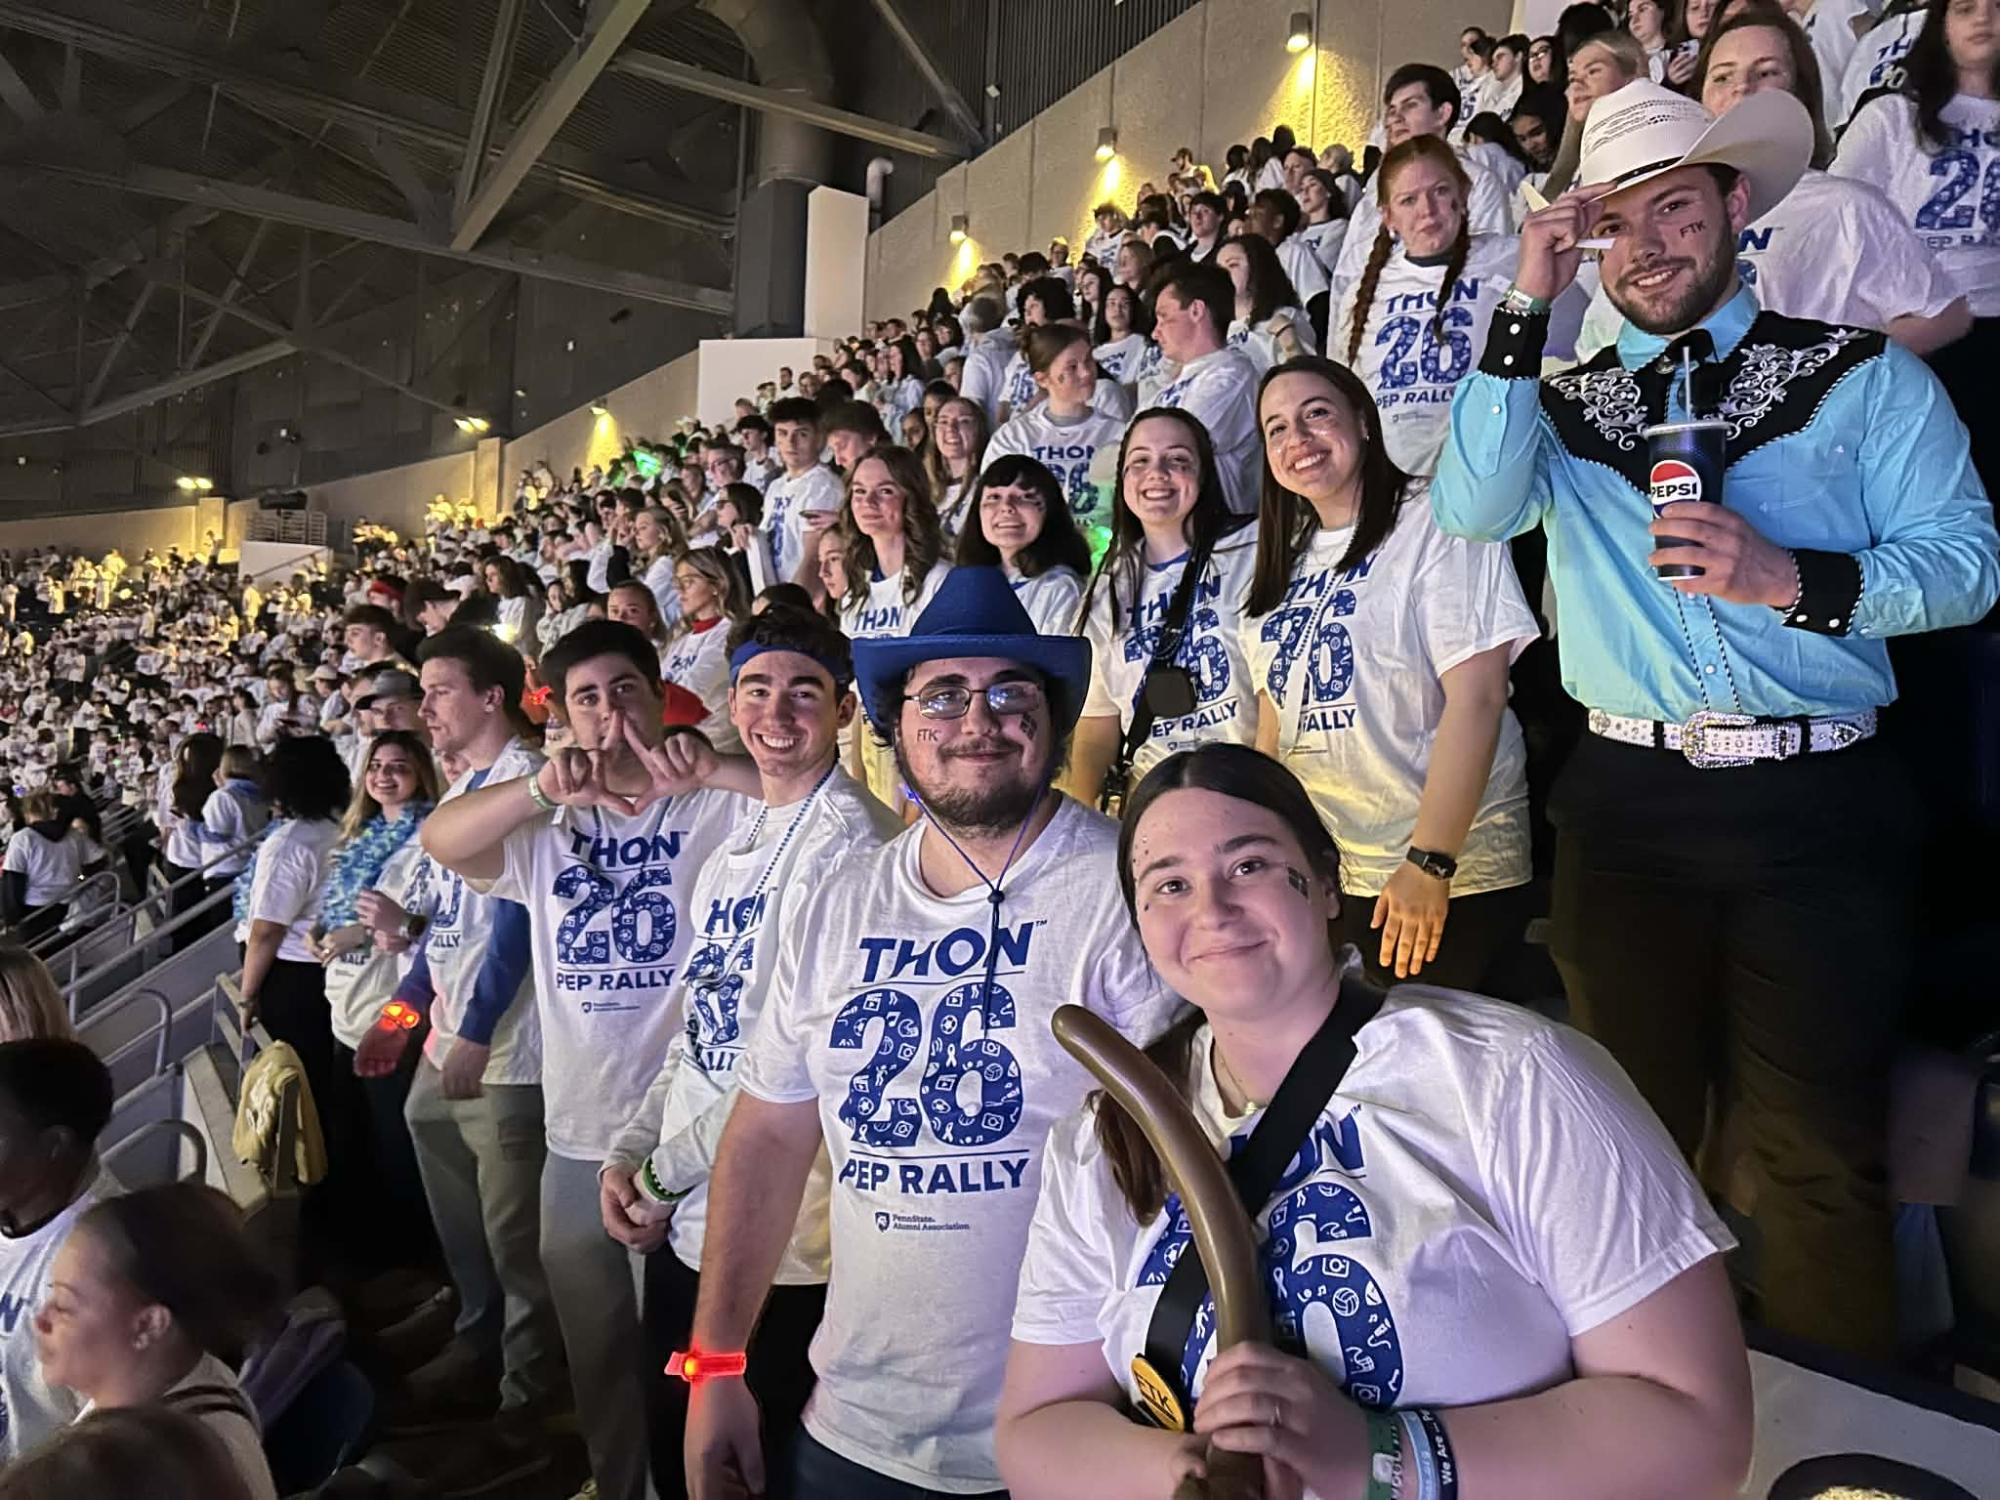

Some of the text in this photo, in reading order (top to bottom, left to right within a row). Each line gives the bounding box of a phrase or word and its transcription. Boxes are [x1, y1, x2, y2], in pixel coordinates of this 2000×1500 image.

[1679, 220, 1706, 238] FTK
[1374, 306, 1473, 390] 26
[1285, 554, 1377, 602] THN
[1126, 575, 1221, 628] THN
[917, 728, 938, 741] FTK
[1152, 701, 1237, 738] EP RALLY
[1299, 709, 1356, 732] ALLY
[569, 826, 682, 868] THON
[552, 864, 677, 964] 26
[557, 969, 677, 991] PEP RALLY
[829, 981, 1024, 1148] 26
[838, 1158, 1031, 1194] PEP RALLY
[1435, 1435, 1449, 1458] Are
[1441, 1461, 1453, 1485] We
